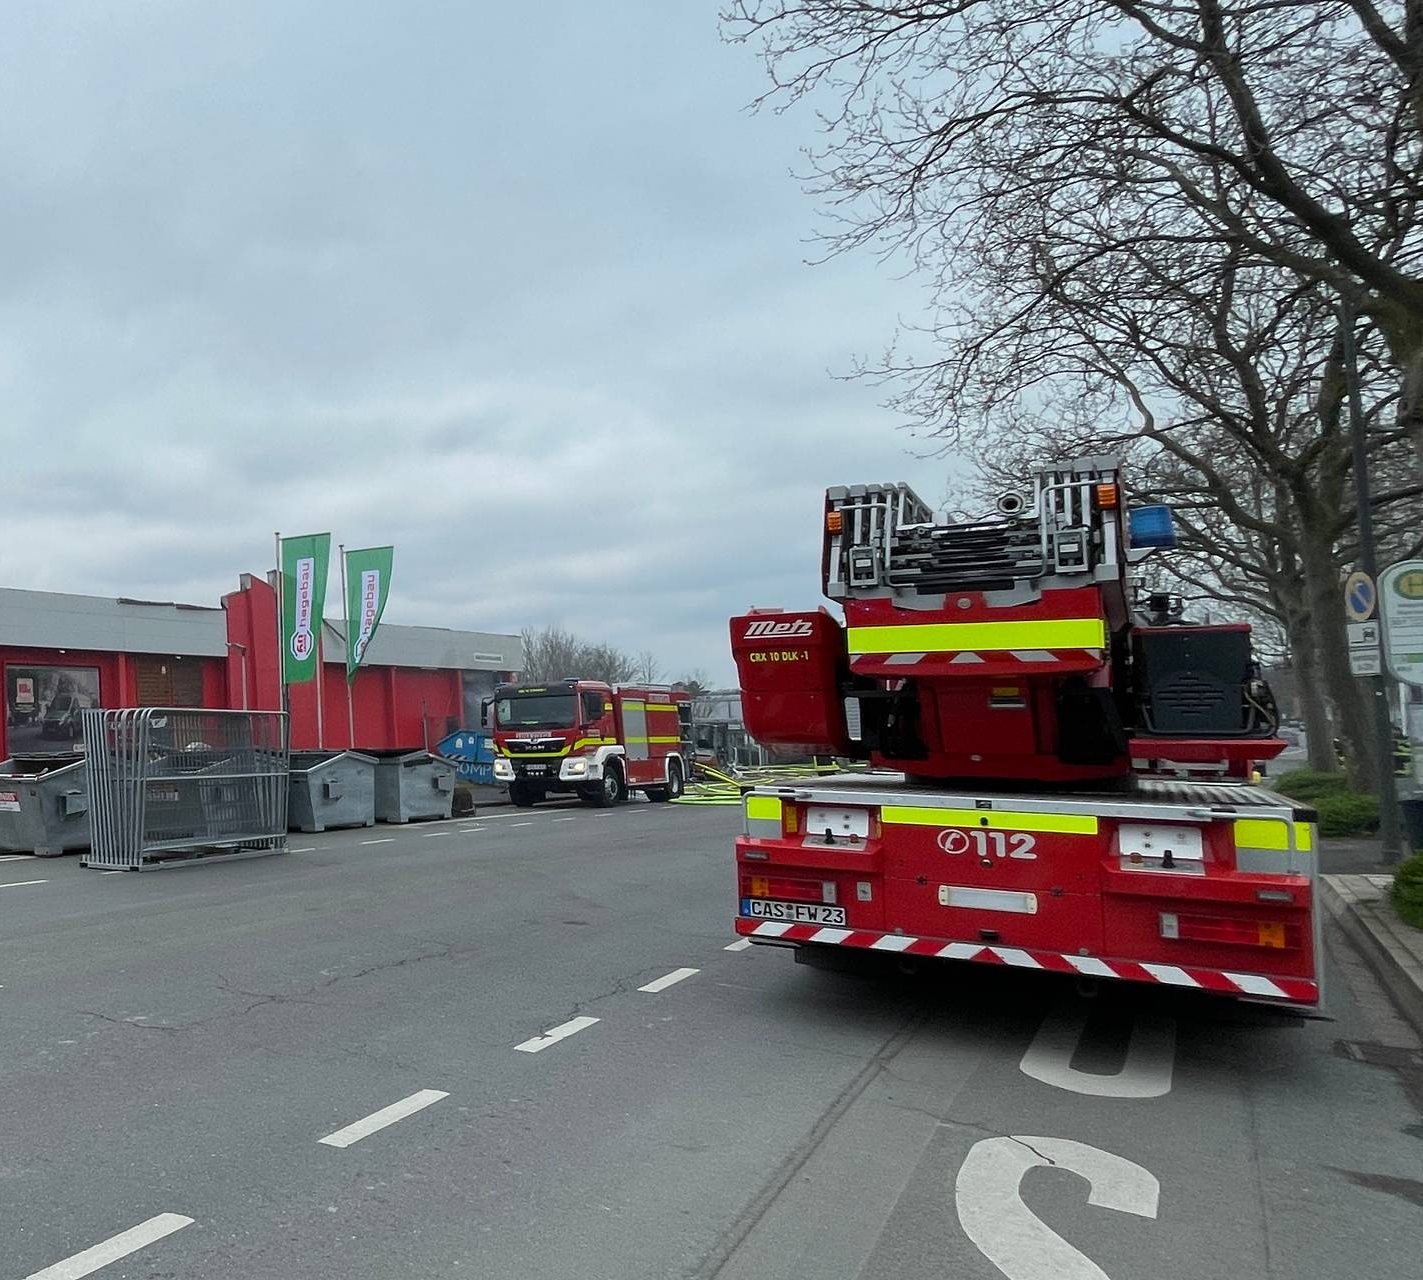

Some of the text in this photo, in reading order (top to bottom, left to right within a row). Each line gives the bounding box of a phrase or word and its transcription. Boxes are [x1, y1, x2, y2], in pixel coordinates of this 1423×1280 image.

[298, 562, 310, 628] hagebau
[362, 574, 376, 635] hagebau
[744, 619, 814, 639] Metz
[749, 652, 767, 662] CRX
[770, 652, 780, 662] 10
[782, 651, 799, 661] DLK
[970, 831, 1038, 860] 112
[752, 901, 844, 924] CAS FW 23
